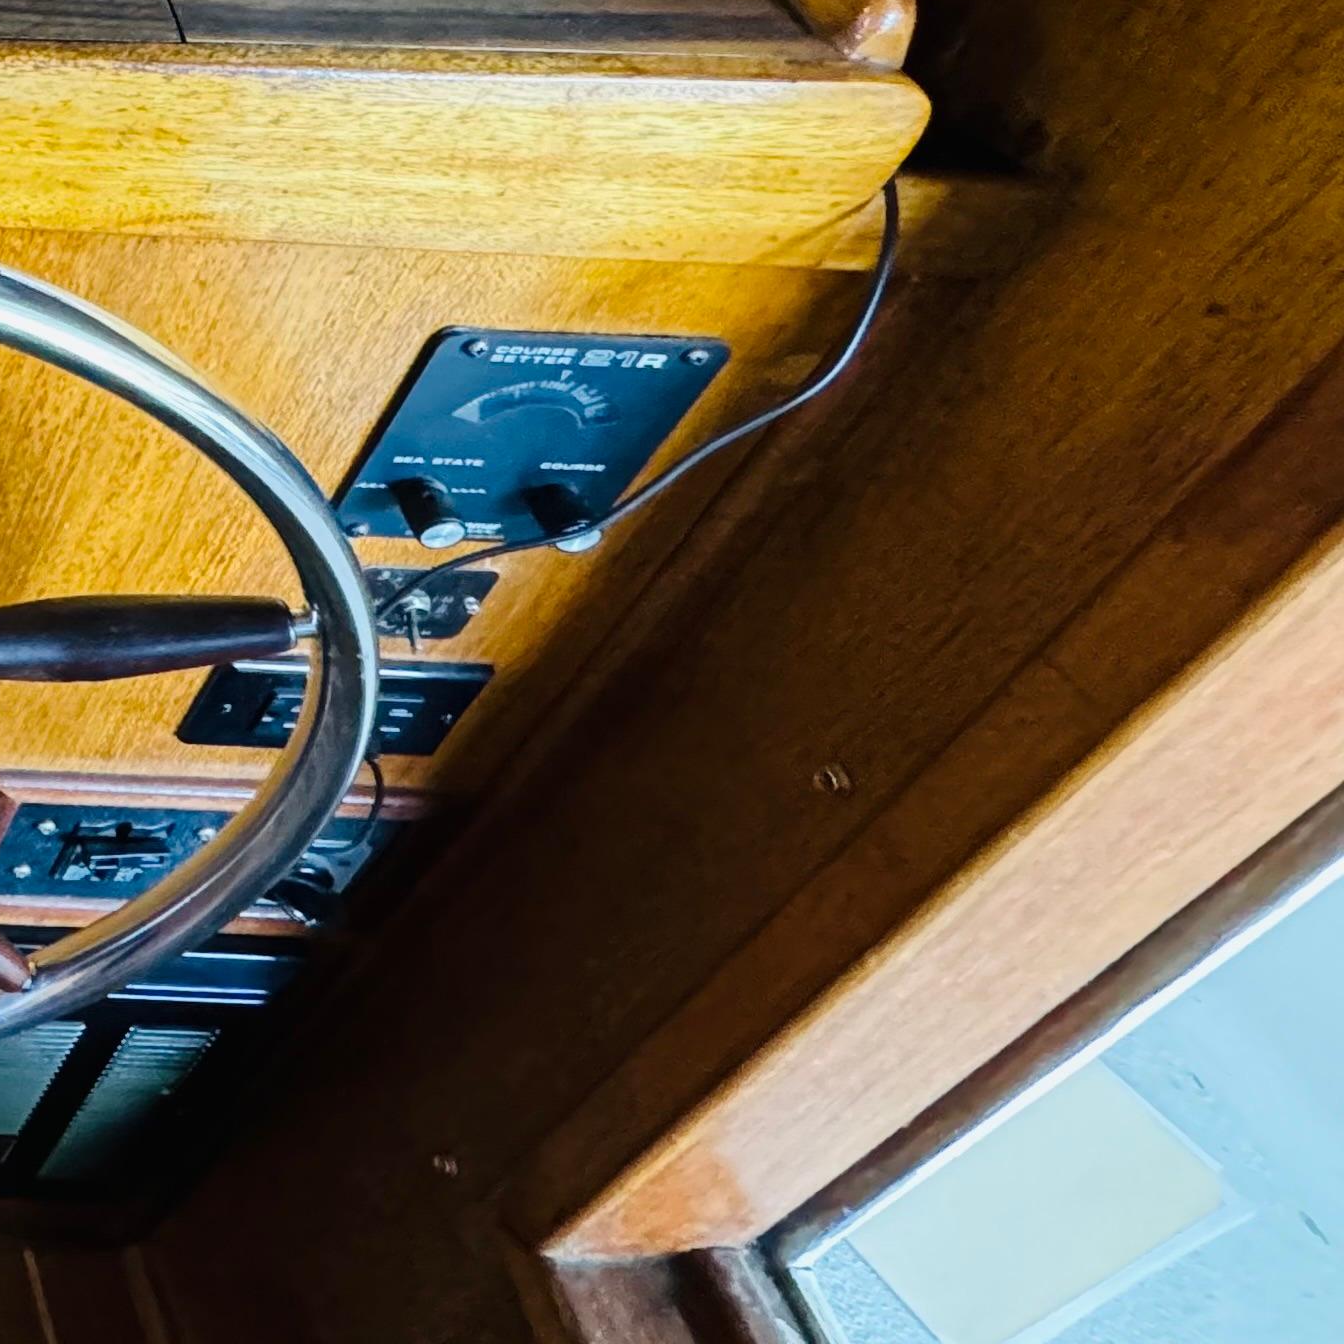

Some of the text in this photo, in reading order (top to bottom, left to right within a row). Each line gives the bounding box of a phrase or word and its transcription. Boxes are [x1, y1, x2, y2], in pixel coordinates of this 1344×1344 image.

[495, 345, 578, 356] COURSE
[489, 354, 573, 365] SETTER
[578, 349, 669, 369] 21R
[392, 455, 486, 467] SEA STATE
[539, 461, 607, 473] COURSE
